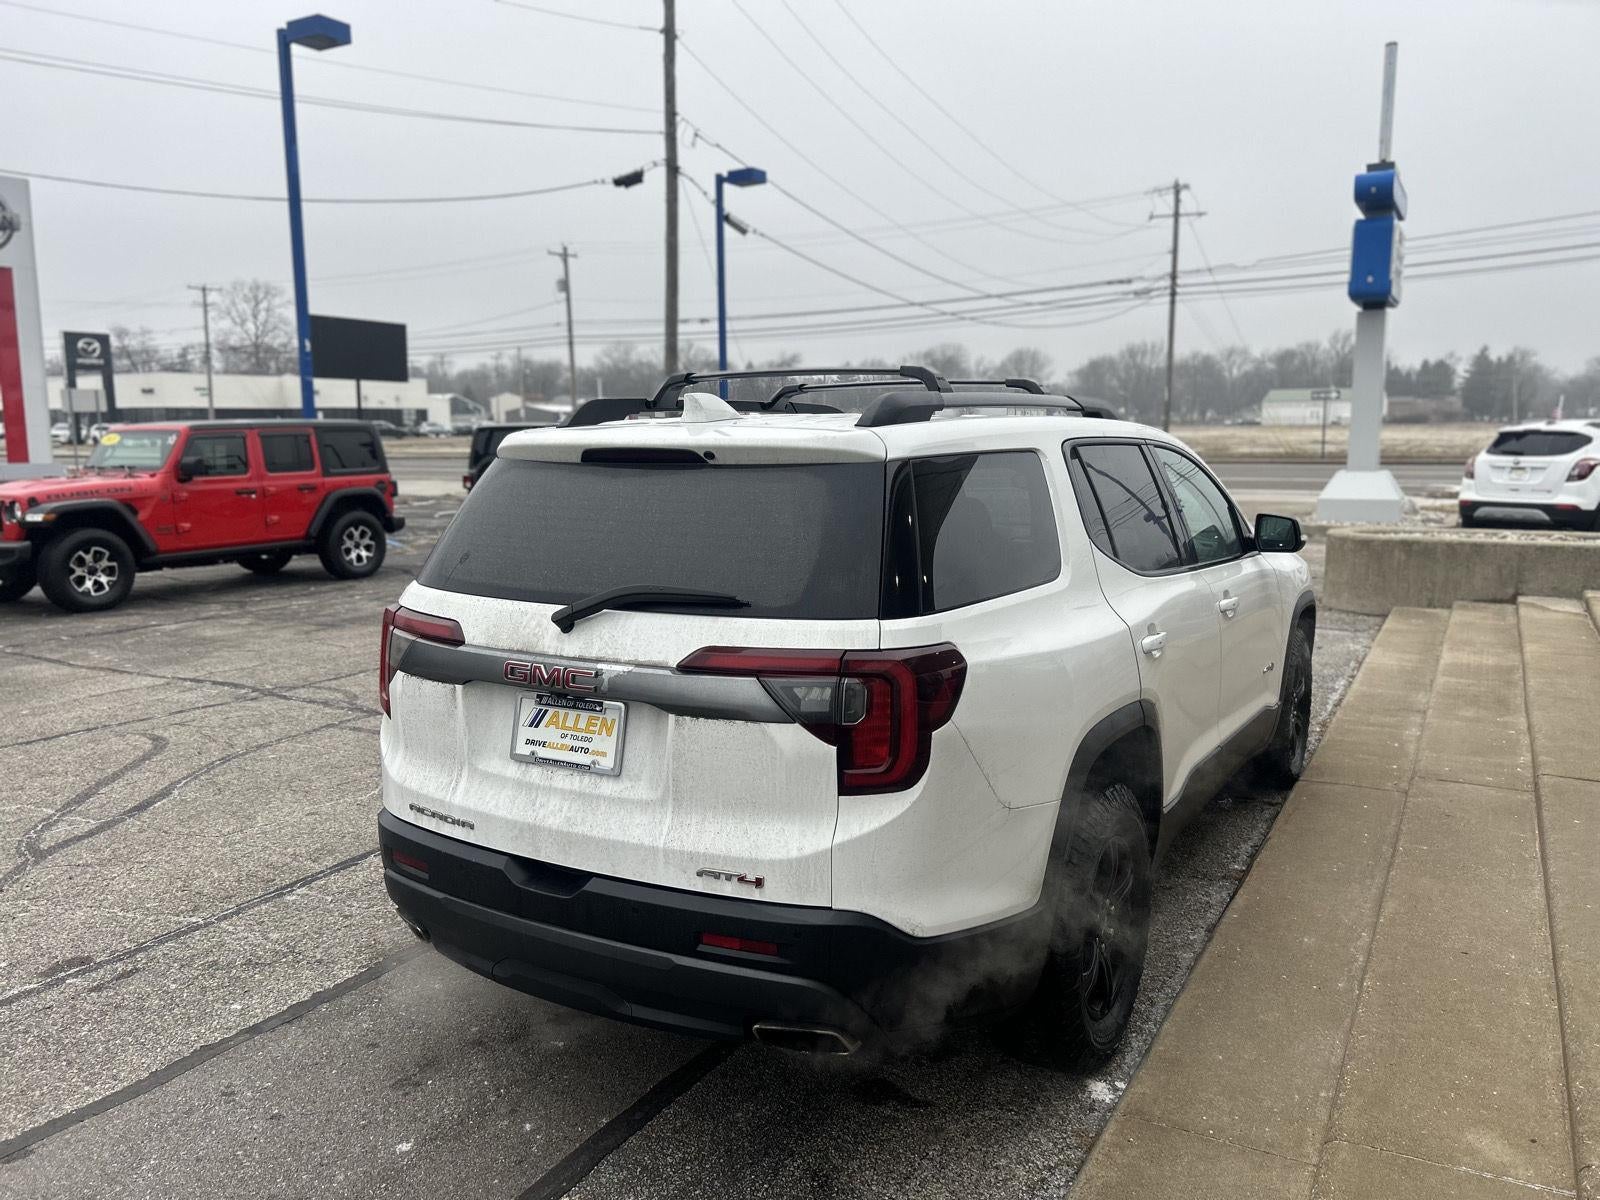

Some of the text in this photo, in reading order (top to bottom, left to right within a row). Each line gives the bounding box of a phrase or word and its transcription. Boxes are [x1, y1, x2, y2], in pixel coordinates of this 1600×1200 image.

[503, 660, 596, 692] GMC
[545, 710, 617, 737] ALLEN
[525, 738, 608, 758] DRIVEALLENAUTO.com
[560, 732, 594, 743] OF TOLEDO
[408, 803, 475, 830] ACADIA
[696, 867, 765, 889] AT4
